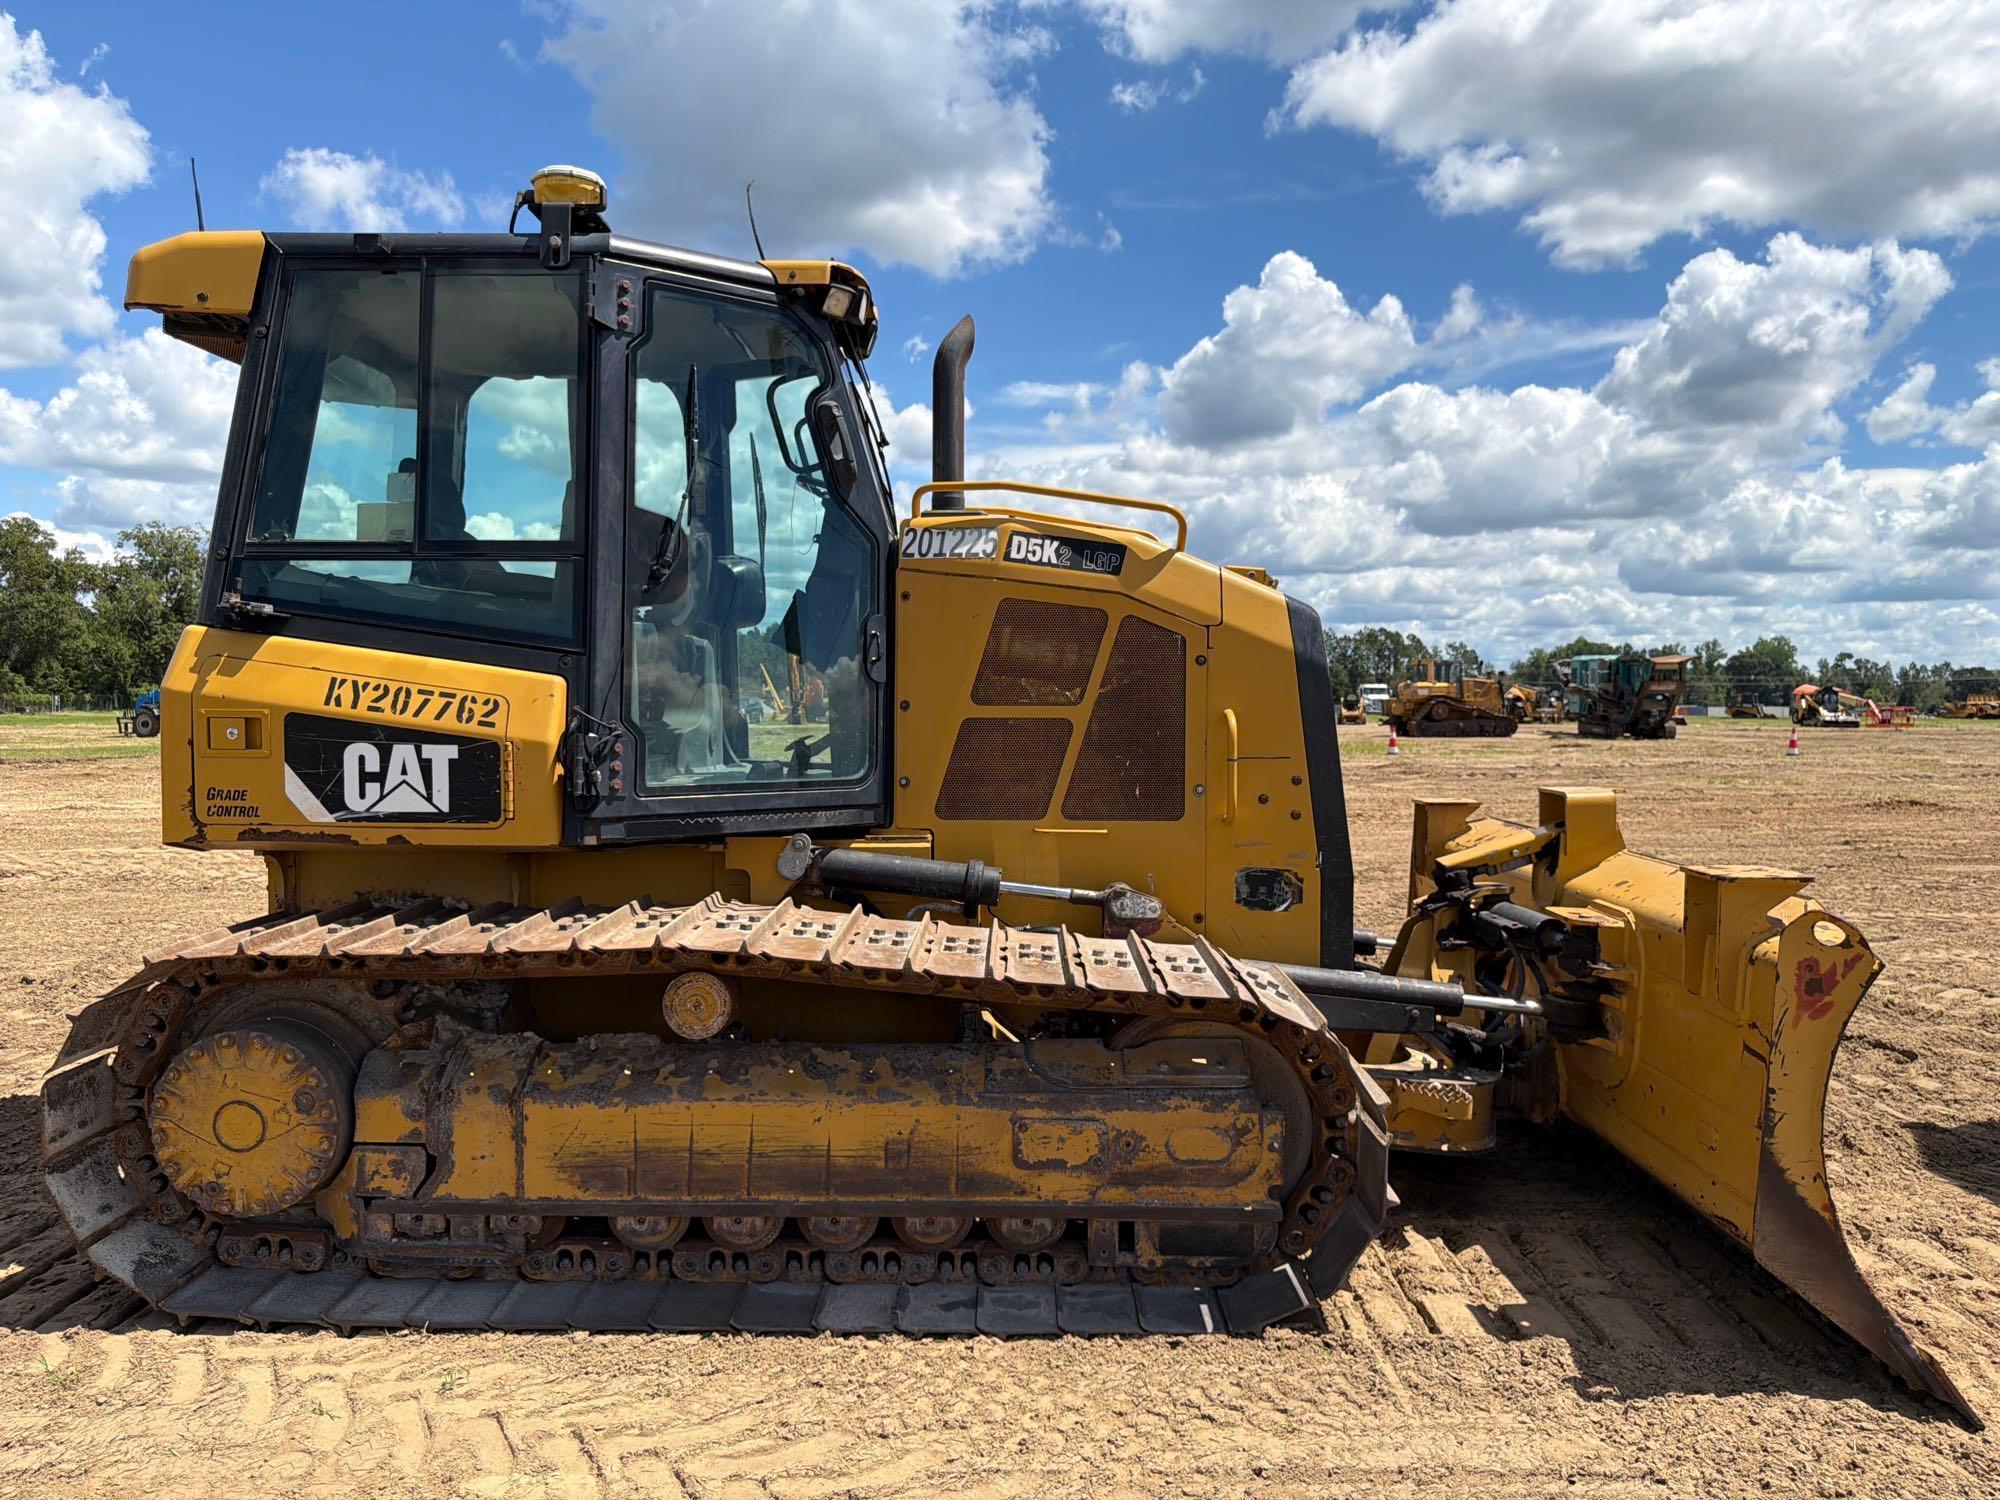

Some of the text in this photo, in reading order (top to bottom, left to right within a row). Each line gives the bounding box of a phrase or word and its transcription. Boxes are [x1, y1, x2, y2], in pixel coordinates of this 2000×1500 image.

[902, 527, 997, 558] 201225
[1082, 550, 1121, 572] LGP
[323, 676, 500, 728] KY207762
[343, 742, 459, 813] CAT
[206, 786, 249, 802] GRADE
[206, 804, 261, 818] CONTROL
